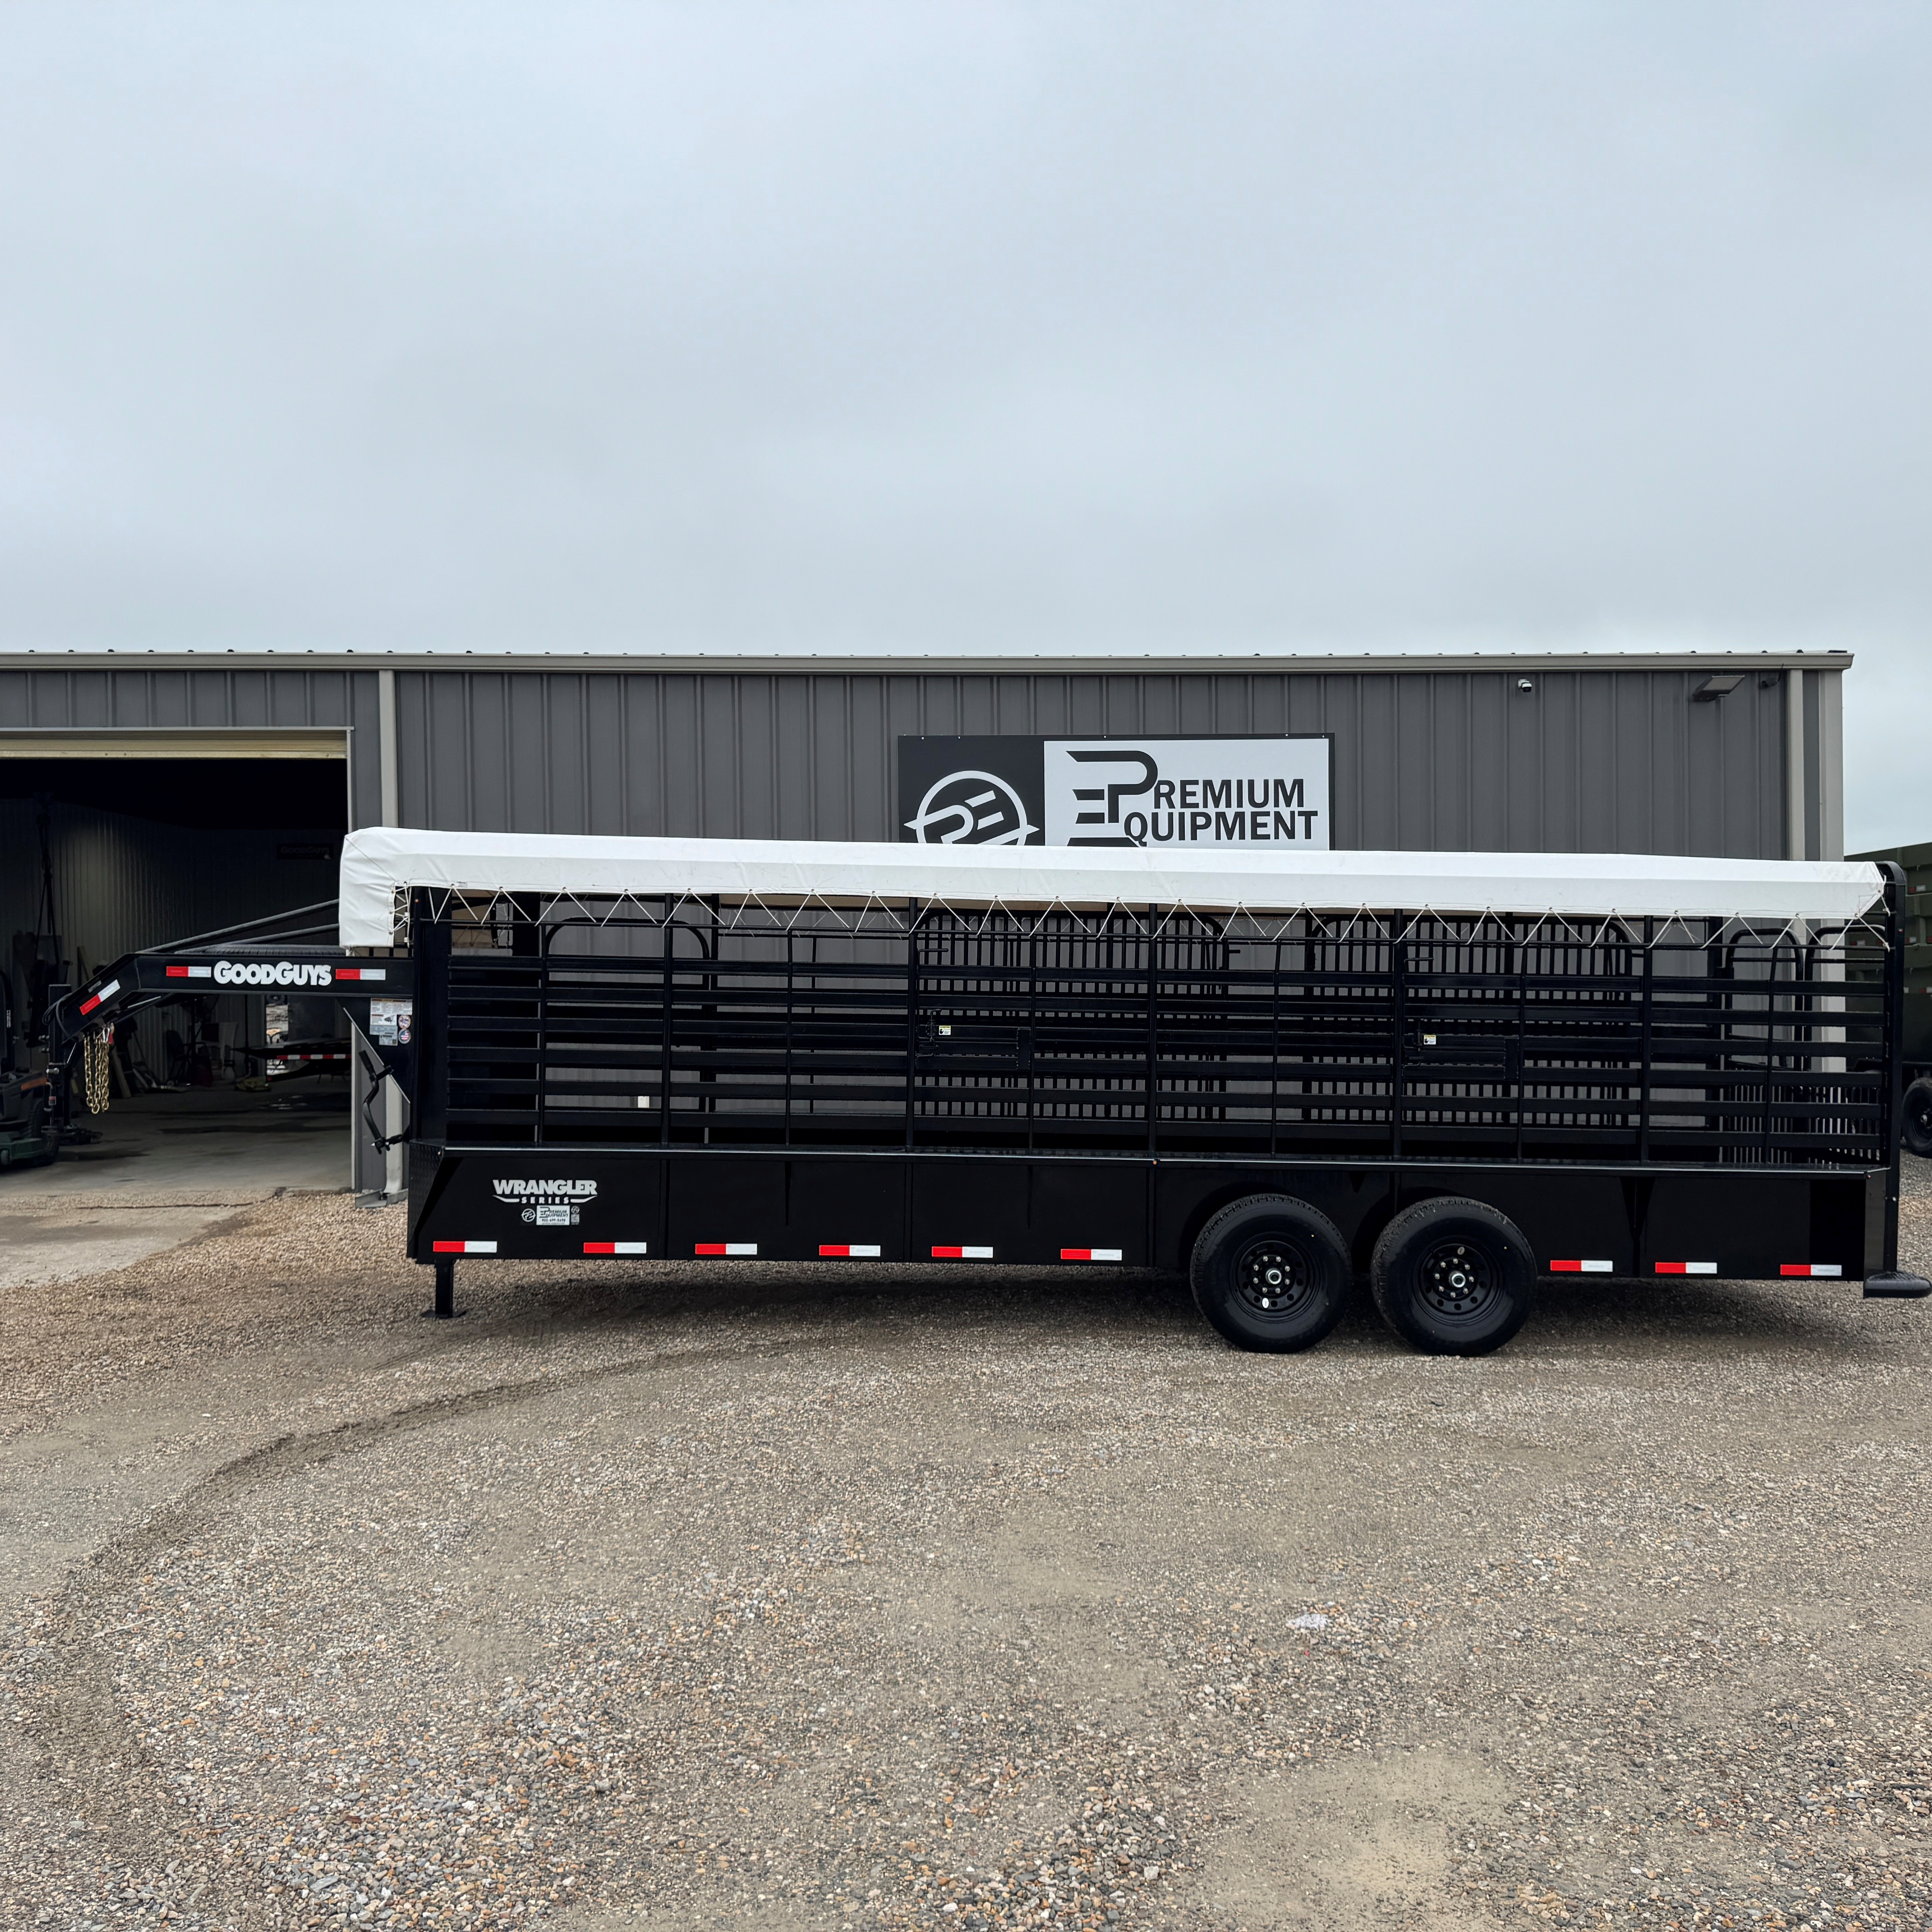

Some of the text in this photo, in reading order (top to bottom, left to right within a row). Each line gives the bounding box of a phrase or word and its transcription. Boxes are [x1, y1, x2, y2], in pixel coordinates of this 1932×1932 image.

[1066, 750, 1304, 823] PREMIUM
[1067, 789, 1318, 847] EQUIPMENT
[214, 961, 331, 986] GOODGUYS
[492, 1179, 598, 1195] WRANGLER
